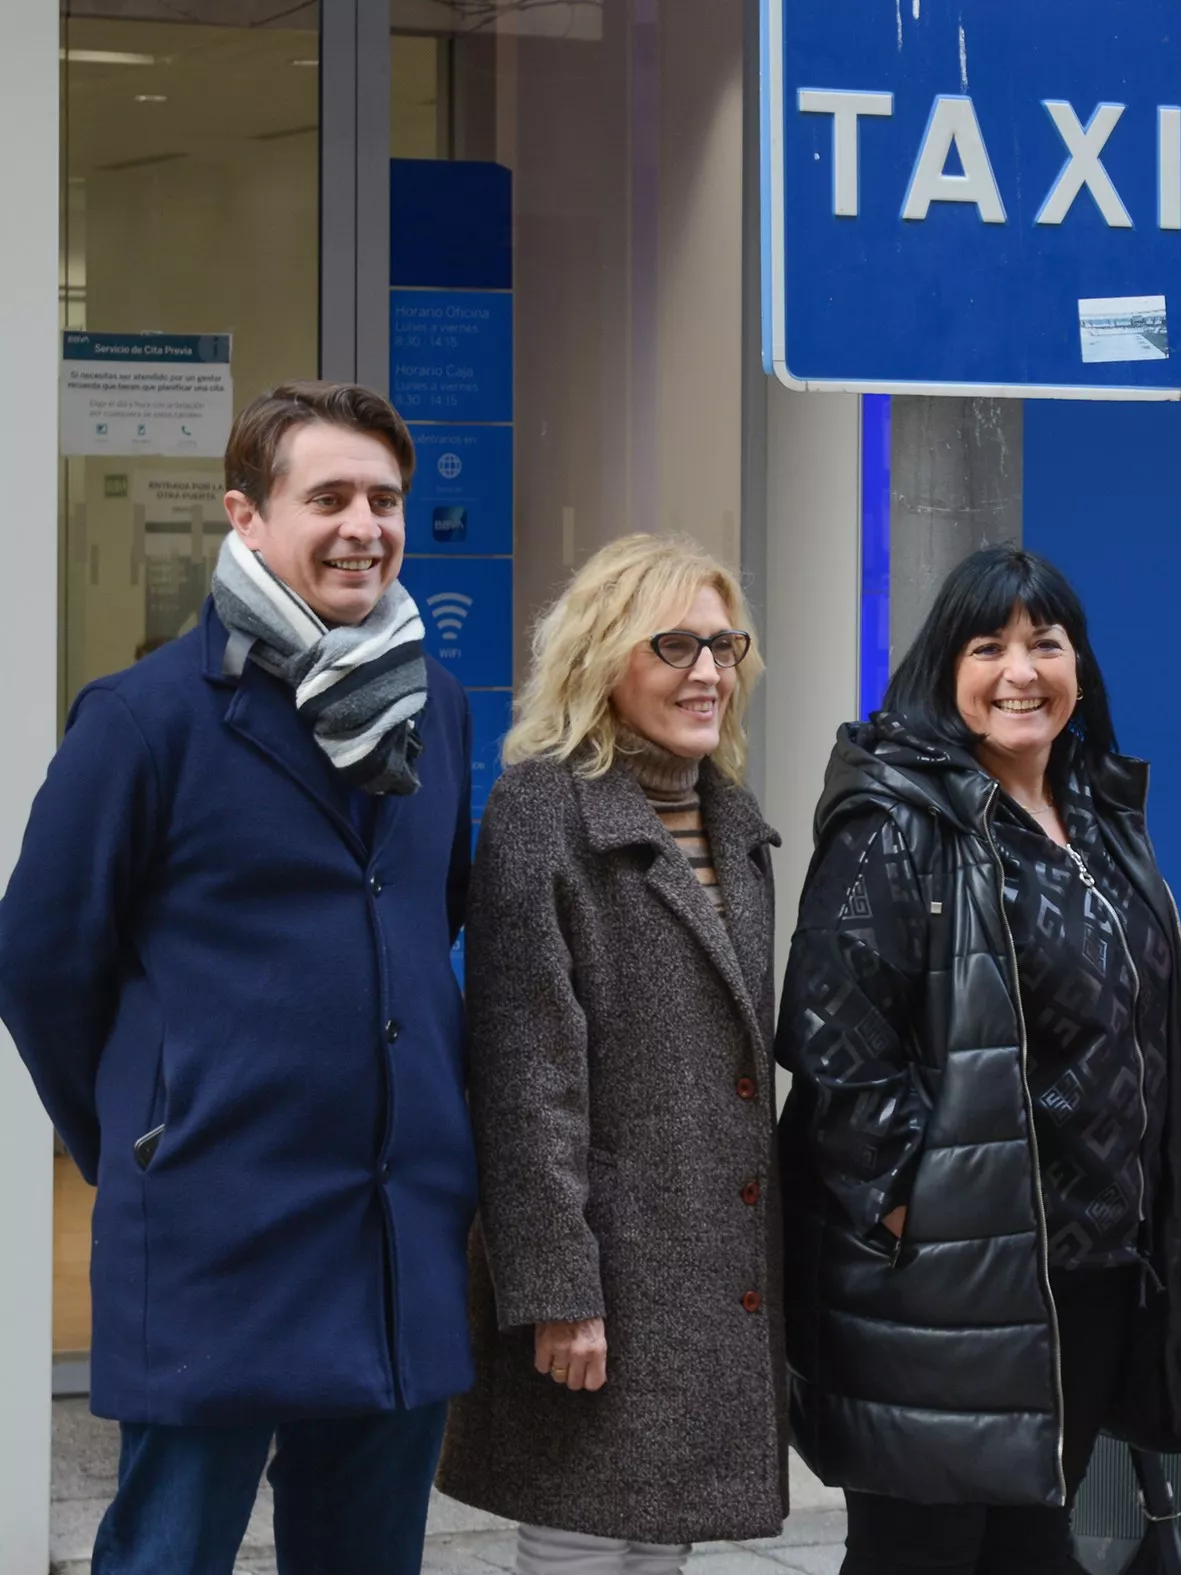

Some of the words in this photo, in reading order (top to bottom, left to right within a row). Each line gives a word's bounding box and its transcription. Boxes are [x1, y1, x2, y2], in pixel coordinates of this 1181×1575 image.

[395, 306, 443, 317] Horario
[445, 306, 490, 319] Oficina
[396, 322, 427, 332] Lunes
[440, 323, 479, 333] viernes
[94, 344, 130, 354] Servicio
[131, 345, 143, 354] de
[144, 345, 164, 355] Cita
[165, 346, 193, 355] Previa
[70, 371, 79, 379] Si
[80, 372, 118, 380] necesitas
[133, 373, 169, 381] atendido
[169, 375, 183, 383] por
[197, 374, 222, 383] gestor
[395, 364, 443, 376] Horario
[445, 365, 474, 379] Caja
[102, 383, 117, 391] que
[142, 384, 156, 392] que
[157, 383, 192, 393] planificar
[396, 381, 428, 392] Lunes
[148, 481, 191, 490] ENTRADA
[434, 519, 465, 531] BBVA
